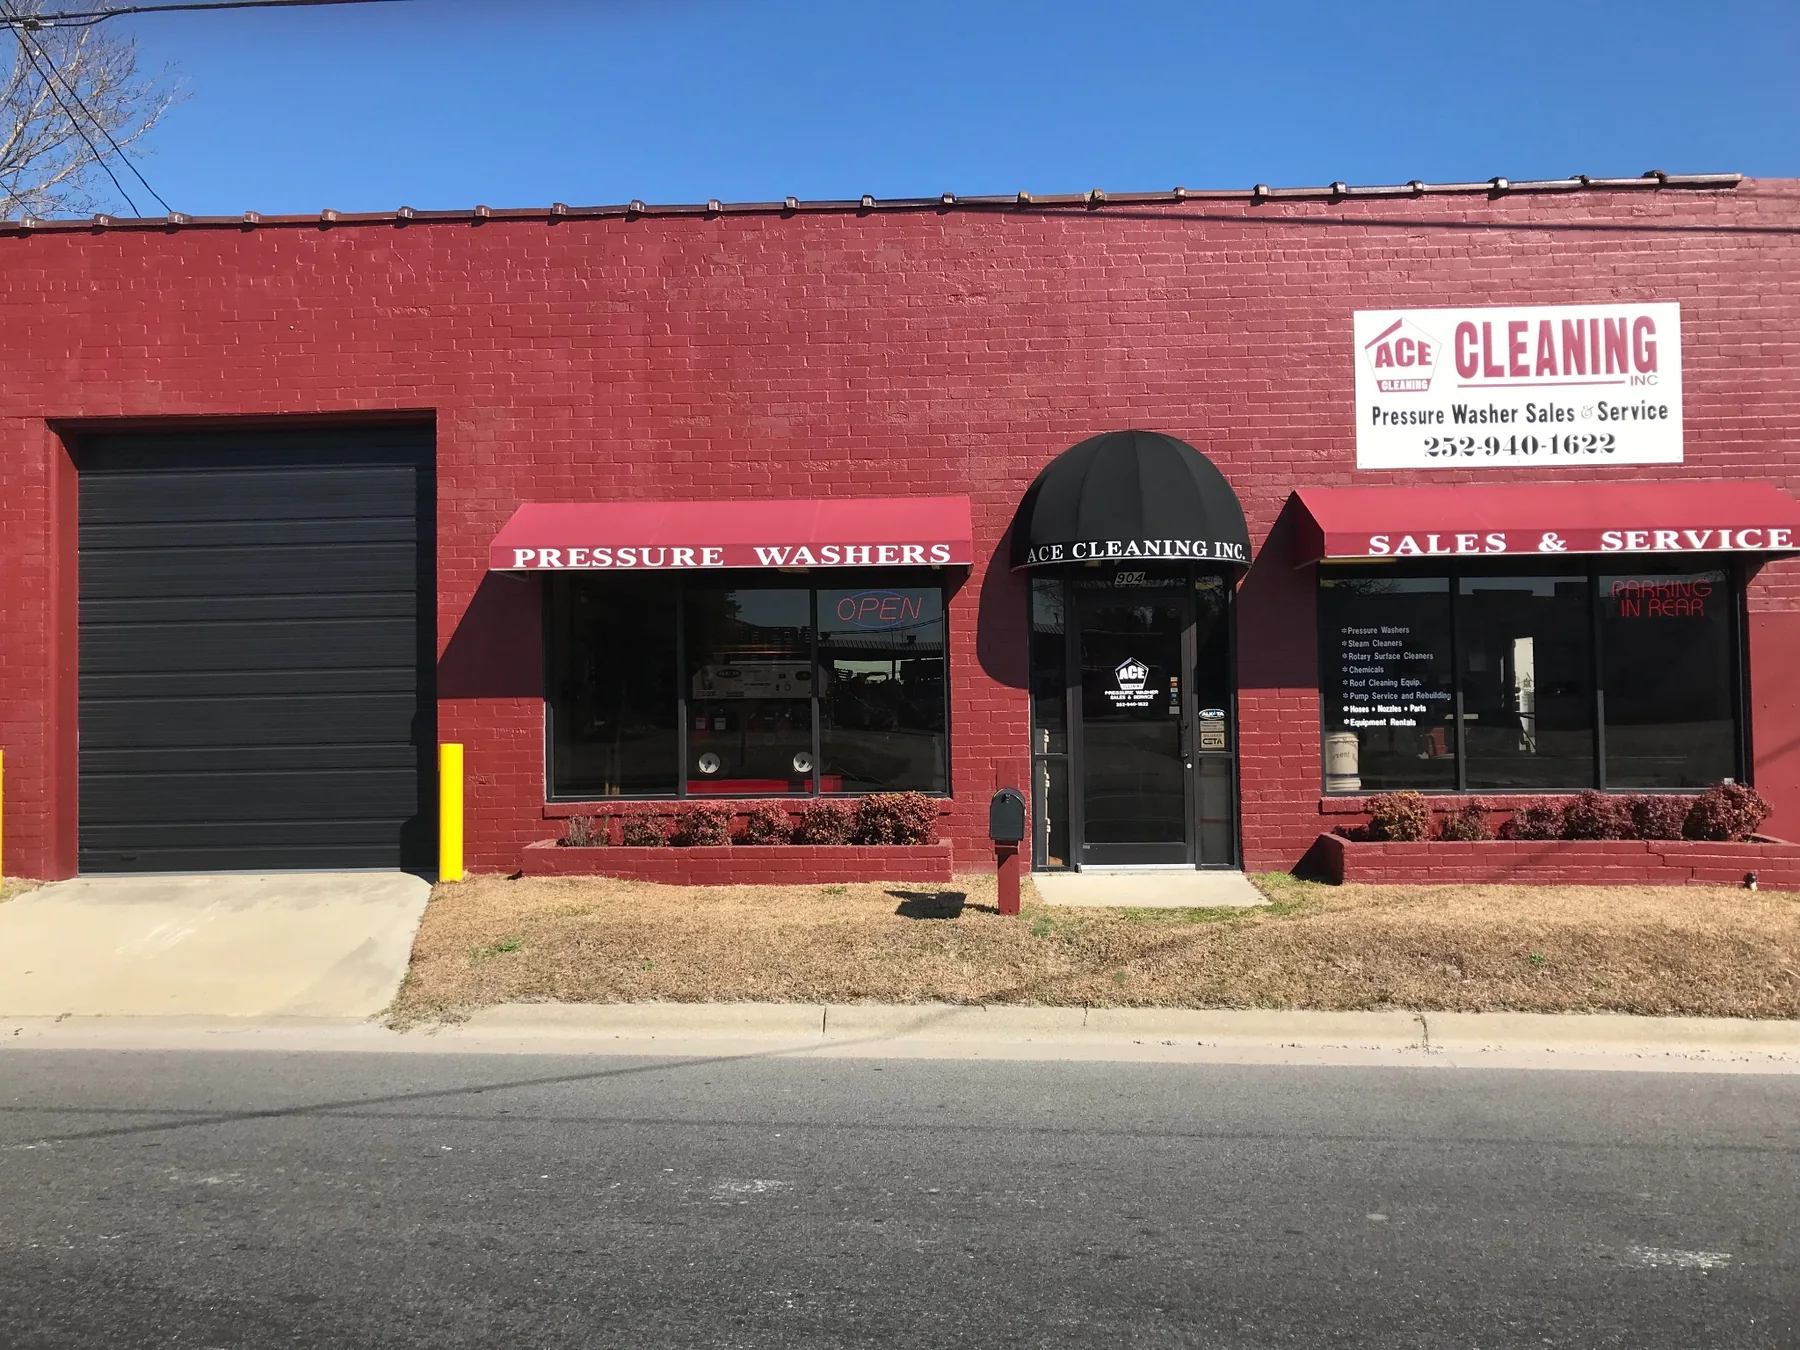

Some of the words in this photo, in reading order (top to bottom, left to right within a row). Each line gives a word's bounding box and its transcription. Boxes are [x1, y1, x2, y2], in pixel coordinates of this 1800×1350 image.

[1374, 337, 1433, 369] ACE
[1454, 315, 1658, 379] CLEANING
[1381, 379, 1429, 392] CLEANING
[1630, 374, 1659, 387] INC
[1372, 405, 1445, 426] Pressure
[1451, 403, 1519, 425] Washer
[1526, 402, 1576, 424] Sales
[1580, 403, 1595, 420] &
[1597, 400, 1669, 422] Service
[1423, 432, 1617, 458] 252-940-1622
[1368, 532, 1507, 555] SALES
[1538, 532, 1567, 553] &
[1600, 528, 1794, 551] SERVICE
[512, 546, 724, 568] PRESSURE
[753, 543, 952, 566] WASHERS
[1027, 544, 1064, 564] ACE
[1072, 540, 1208, 559] CLEANING
[1214, 541, 1246, 561] INC.
[1116, 572, 1145, 584] 904
[1611, 579, 1713, 598] PARKING
[837, 596, 922, 622] OPEN
[1621, 599, 1640, 617] IN
[1648, 598, 1704, 617] REAR
[1347, 626, 1378, 634] Pressure
[1380, 626, 1410, 634] Washers
[1372, 639, 1403, 647] Cleaners
[1348, 652, 1371, 661] Rotary
[1374, 652, 1401, 660] Surface
[1403, 651, 1434, 660] Cleaners
[1119, 665, 1145, 680] ACE
[1348, 665, 1385, 673] Chemicals
[1349, 679, 1366, 687] Roof
[1368, 678, 1398, 688] Cleaning
[1400, 678, 1422, 687] Equip.
[1349, 692, 1369, 701] Pump
[1372, 691, 1398, 700] Service
[1401, 691, 1414, 700] and
[1416, 691, 1452, 701] Rebuilding
[1349, 705, 1370, 713] Hoses
[1377, 704, 1402, 713] Nozzles
[1409, 704, 1427, 712] Parts
[1350, 718, 1387, 728] Equipment
[1390, 717, 1417, 726] Rentals
